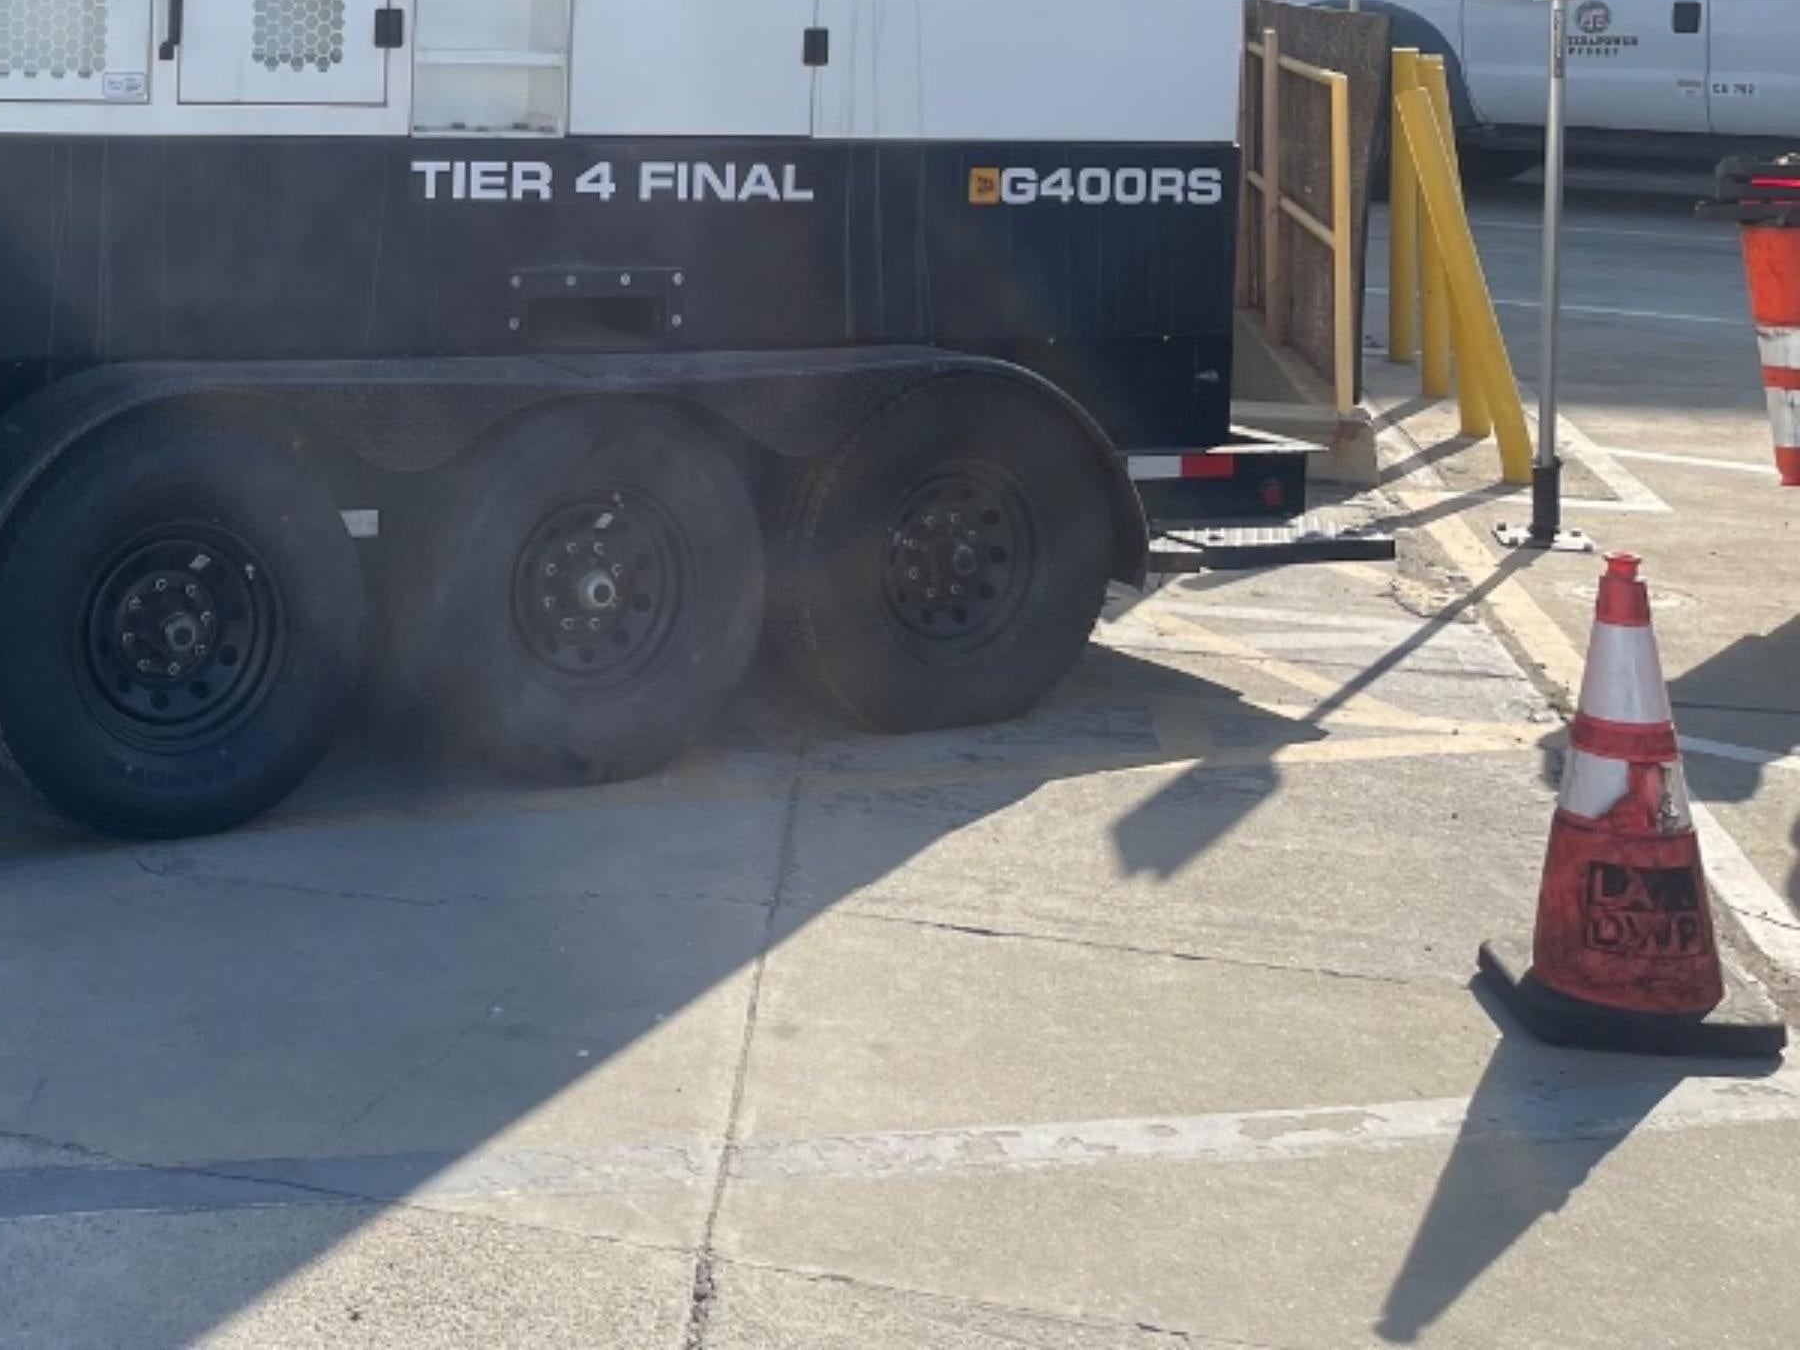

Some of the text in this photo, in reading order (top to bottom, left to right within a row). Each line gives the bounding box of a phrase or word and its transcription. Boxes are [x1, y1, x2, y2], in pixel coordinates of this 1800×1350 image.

[411, 161, 814, 203] TIER 4 FINAL
[1001, 167, 1222, 204] G400RS
